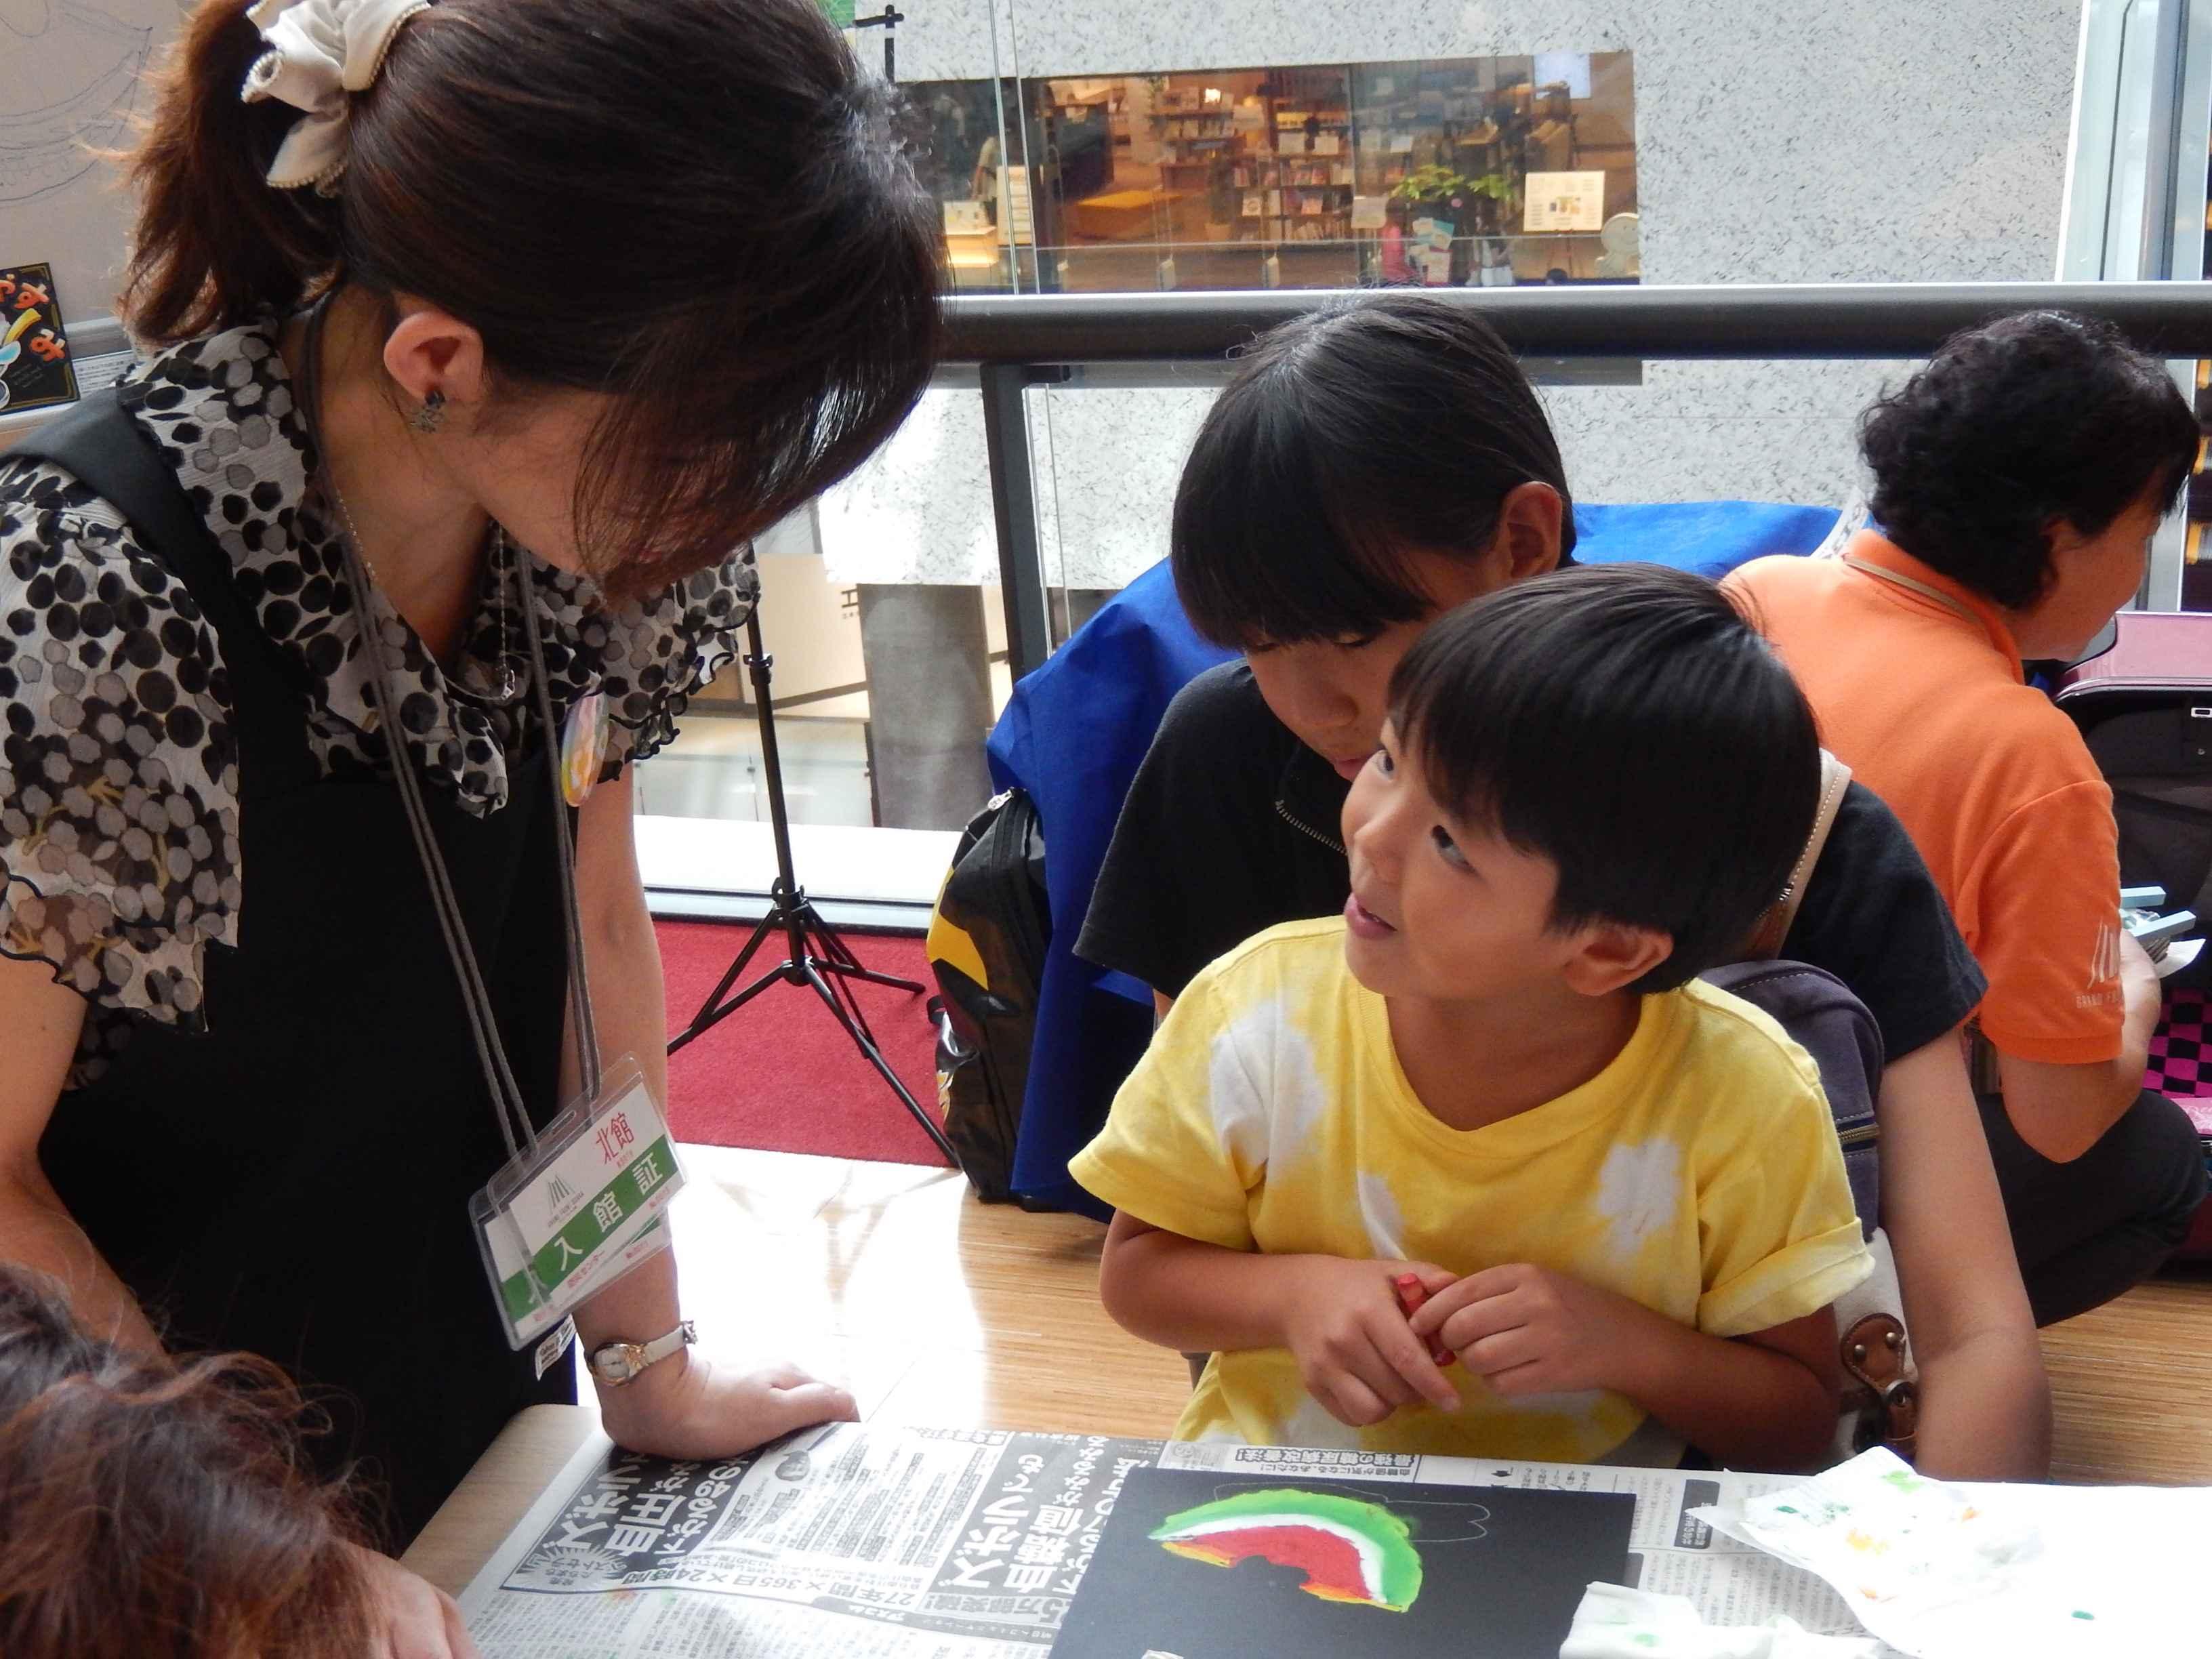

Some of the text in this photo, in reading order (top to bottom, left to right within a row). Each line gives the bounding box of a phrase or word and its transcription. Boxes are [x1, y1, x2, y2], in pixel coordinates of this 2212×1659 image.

[596, 1112, 636, 1164] 北館
[553, 1156, 663, 1271] 入館証
[939, 1454, 1045, 1589] ズボラでも
[1004, 1434, 1109, 1594] 血糖値がみるみる
[1052, 1456, 1150, 1594] 下がる7の方法
[926, 1594, 1071, 1624] 5万部突破!
